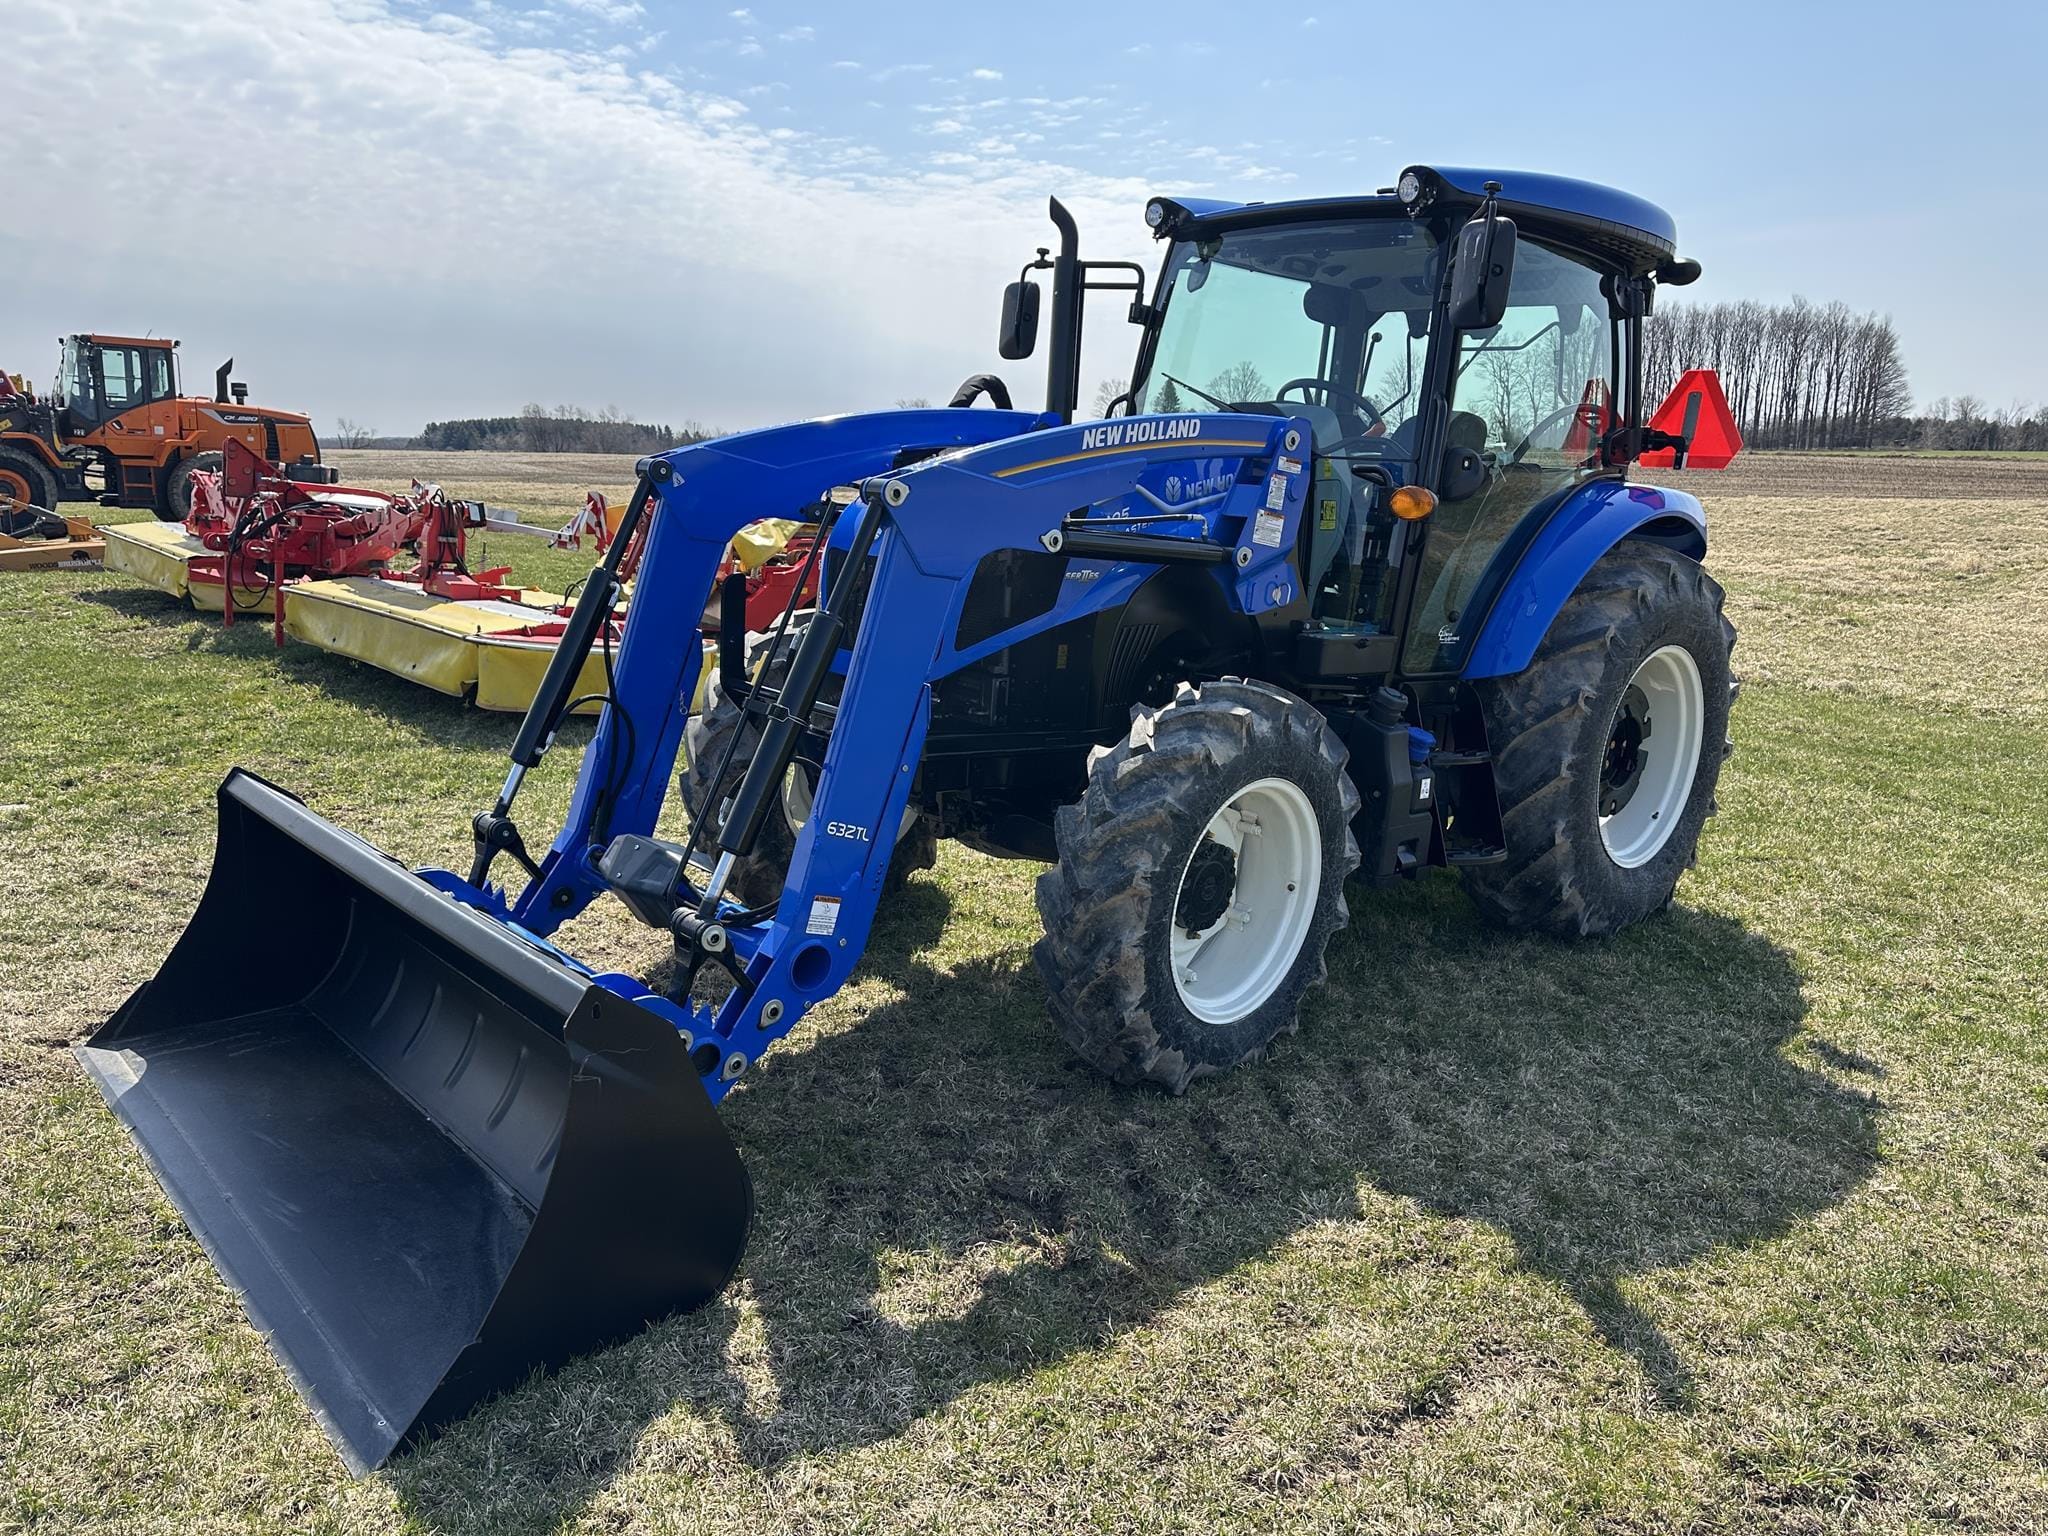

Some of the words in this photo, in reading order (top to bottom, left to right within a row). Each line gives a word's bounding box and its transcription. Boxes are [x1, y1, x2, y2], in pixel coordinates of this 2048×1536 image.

[1082, 425, 1123, 450] NEW
[1125, 419, 1201, 444] HOLLAND
[1186, 478, 1214, 498] NEW
[1217, 473, 1236, 491] HO
[827, 821, 870, 842] 632TL
